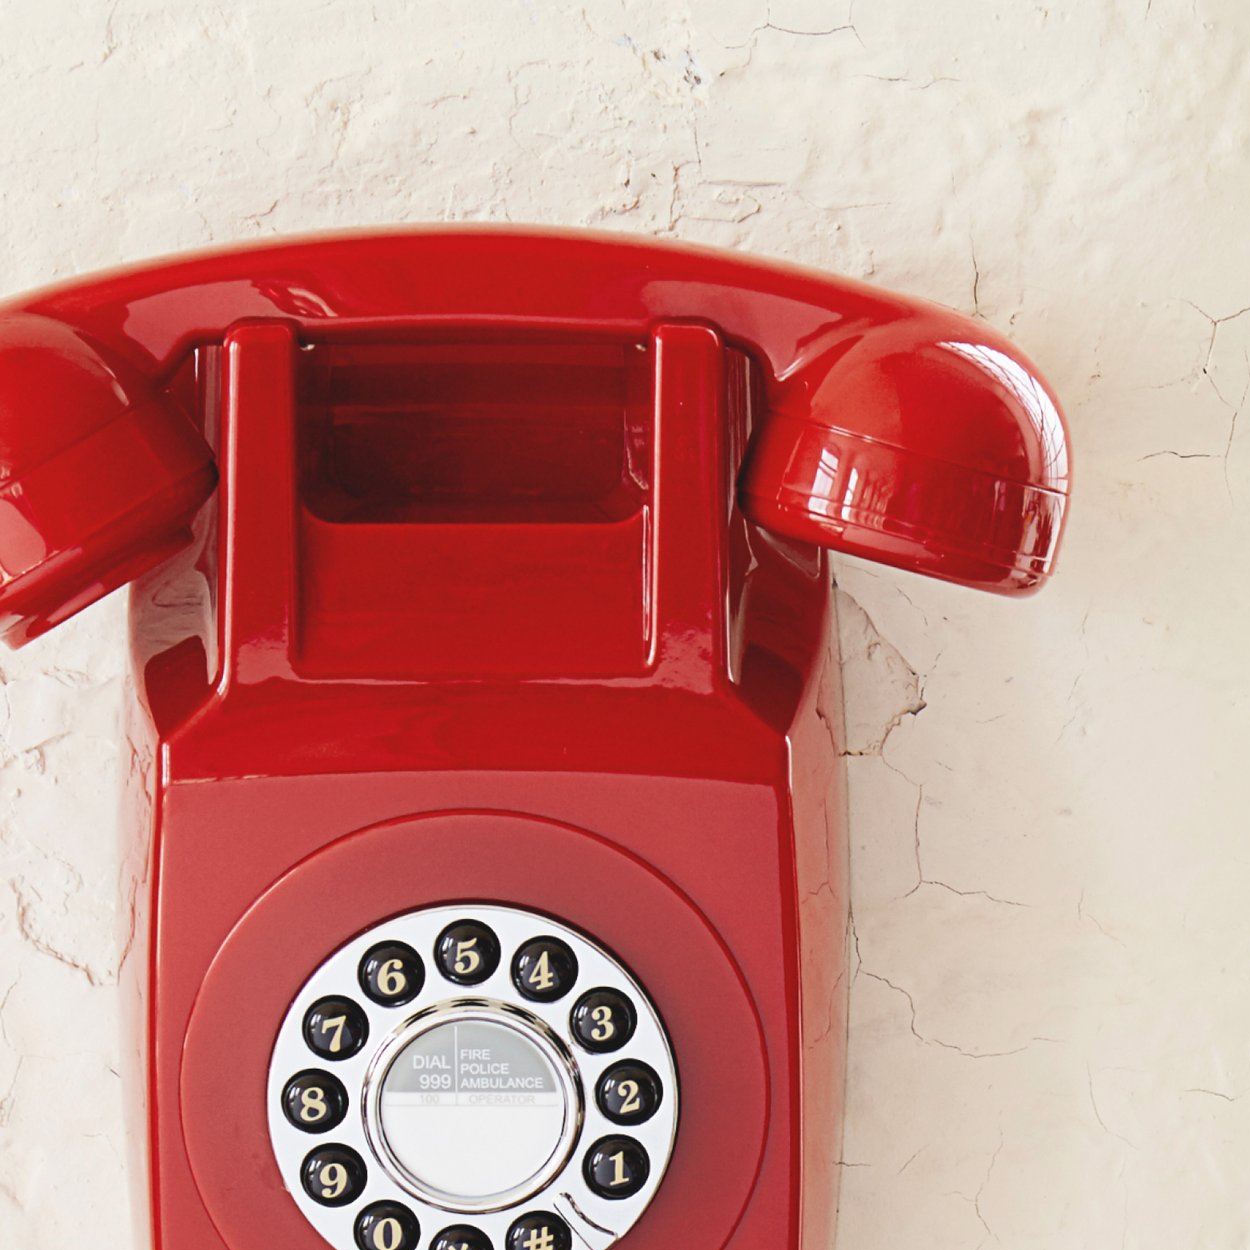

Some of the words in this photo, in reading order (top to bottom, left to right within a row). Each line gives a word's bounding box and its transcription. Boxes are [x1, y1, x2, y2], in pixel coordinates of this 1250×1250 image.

[455, 938, 480, 974] 5
[528, 951, 555, 990] 4
[377, 959, 407, 996] 6
[321, 1014, 348, 1053] 7
[591, 1007, 614, 1041] 3
[412, 1055, 451, 1069] DIAL
[460, 1049, 491, 1061] FIRE
[460, 1063, 510, 1075] POLICE
[419, 1074, 452, 1090] 999
[460, 1077, 544, 1089] AMBULANCE
[616, 1079, 641, 1114] 2
[301, 1087, 327, 1122] 8
[419, 1094, 440, 1105] 100
[468, 1094, 536, 1105] OPERATOR
[320, 1164, 348, 1199] 9
[608, 1150, 630, 1186] 1
